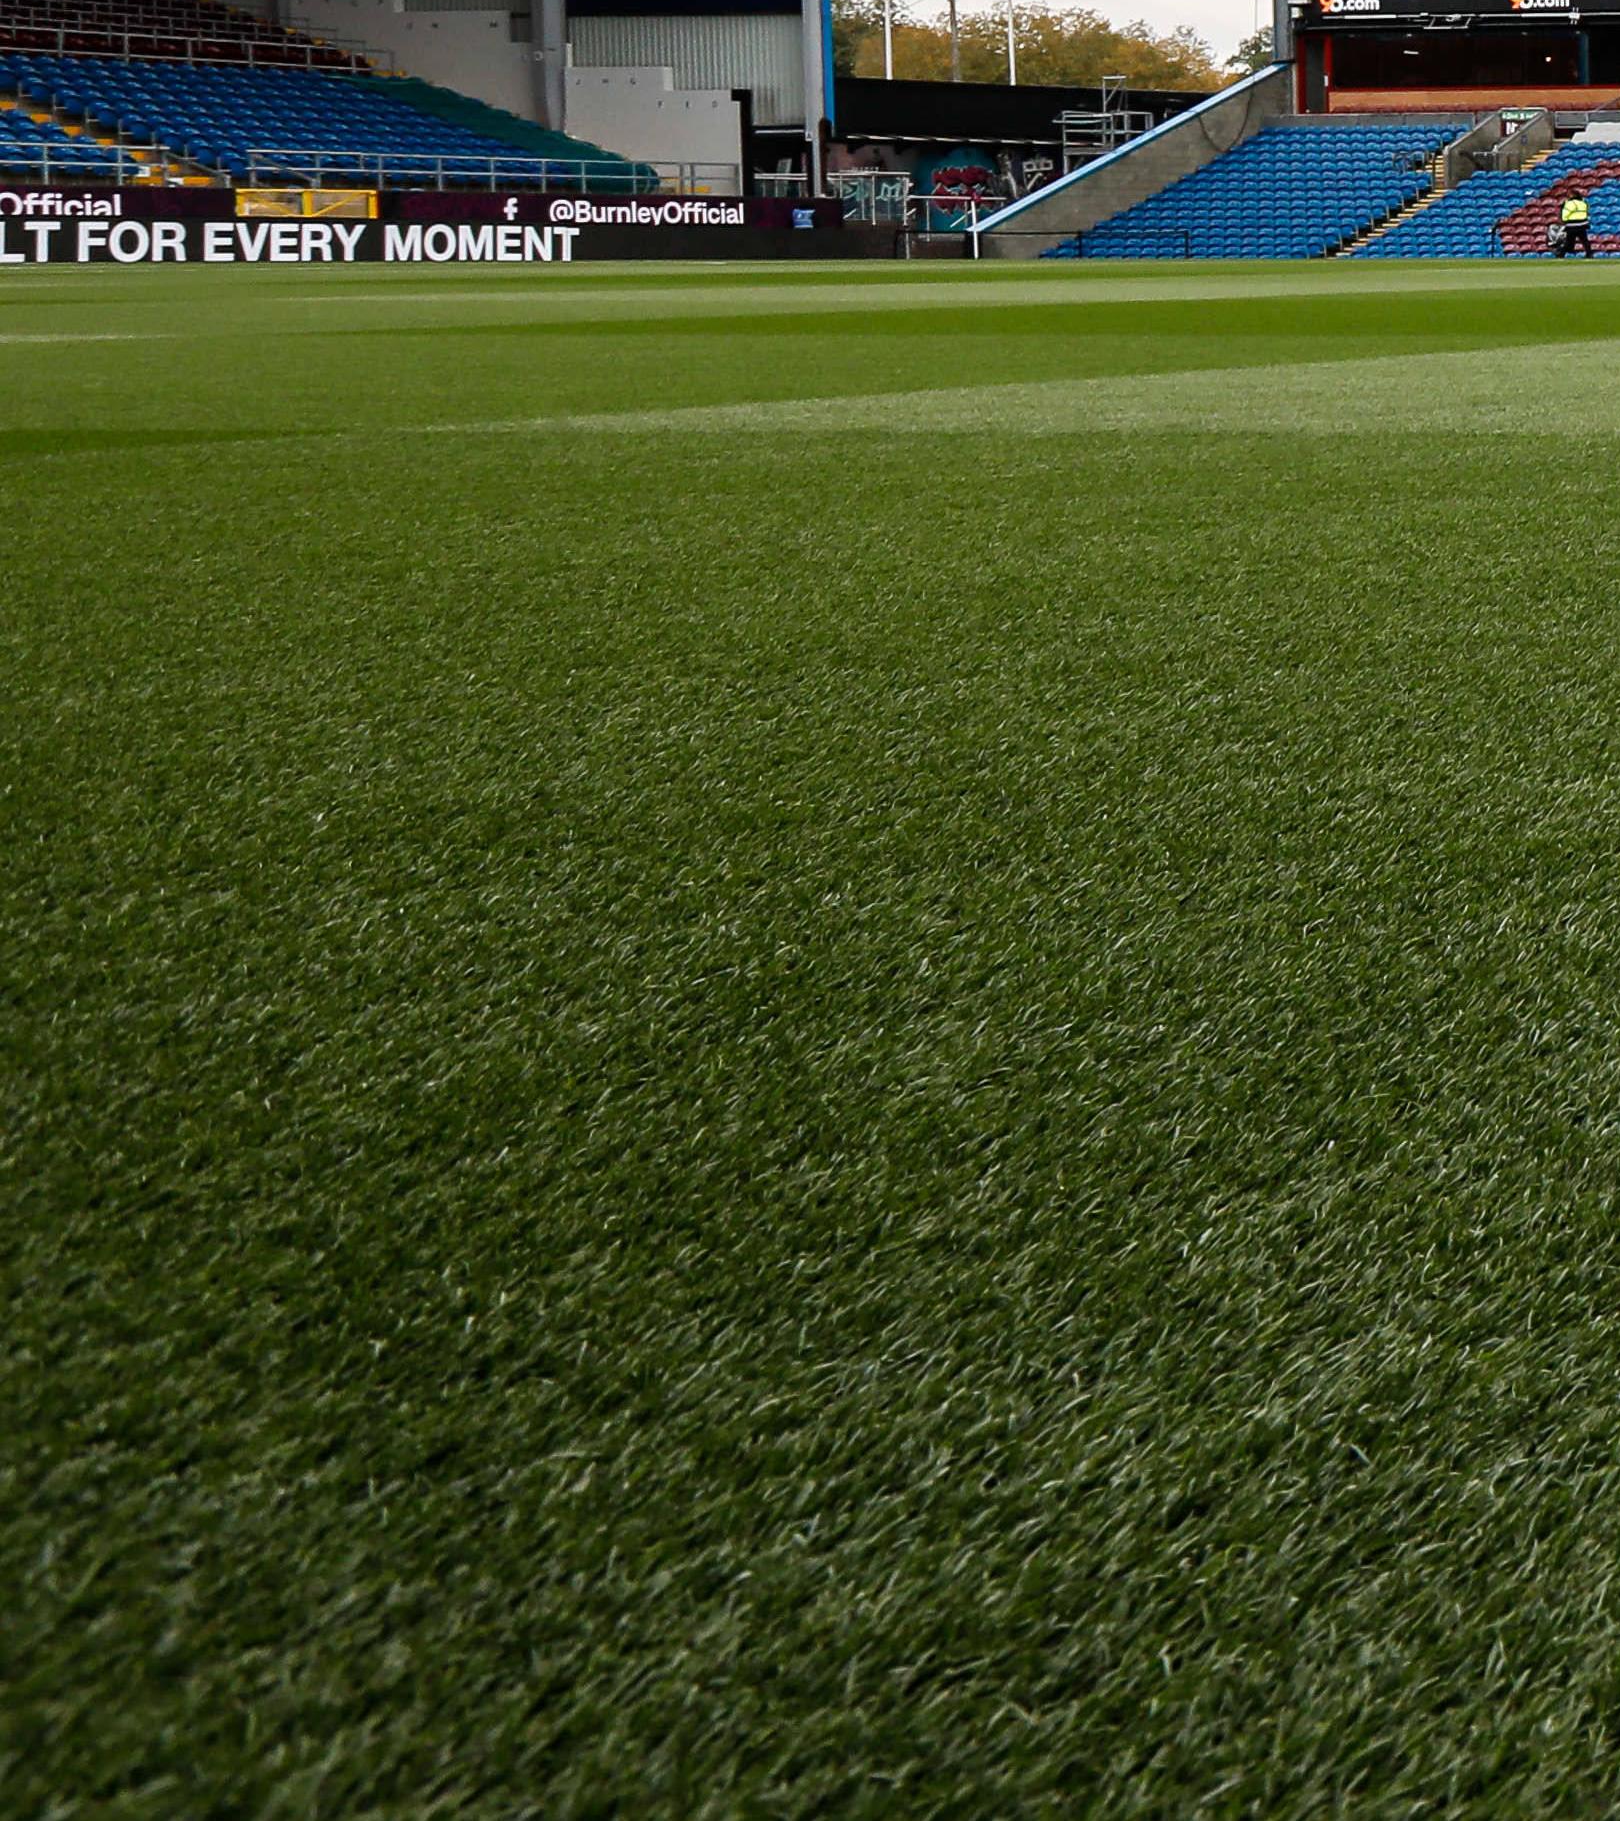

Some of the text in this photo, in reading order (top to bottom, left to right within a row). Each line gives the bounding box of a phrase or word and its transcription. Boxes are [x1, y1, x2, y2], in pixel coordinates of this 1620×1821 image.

[549, 199, 744, 226] @BurnleyOfficial
[77, 222, 187, 263] FOR
[203, 223, 364, 263] EVERY
[384, 224, 579, 263] MOMENT
